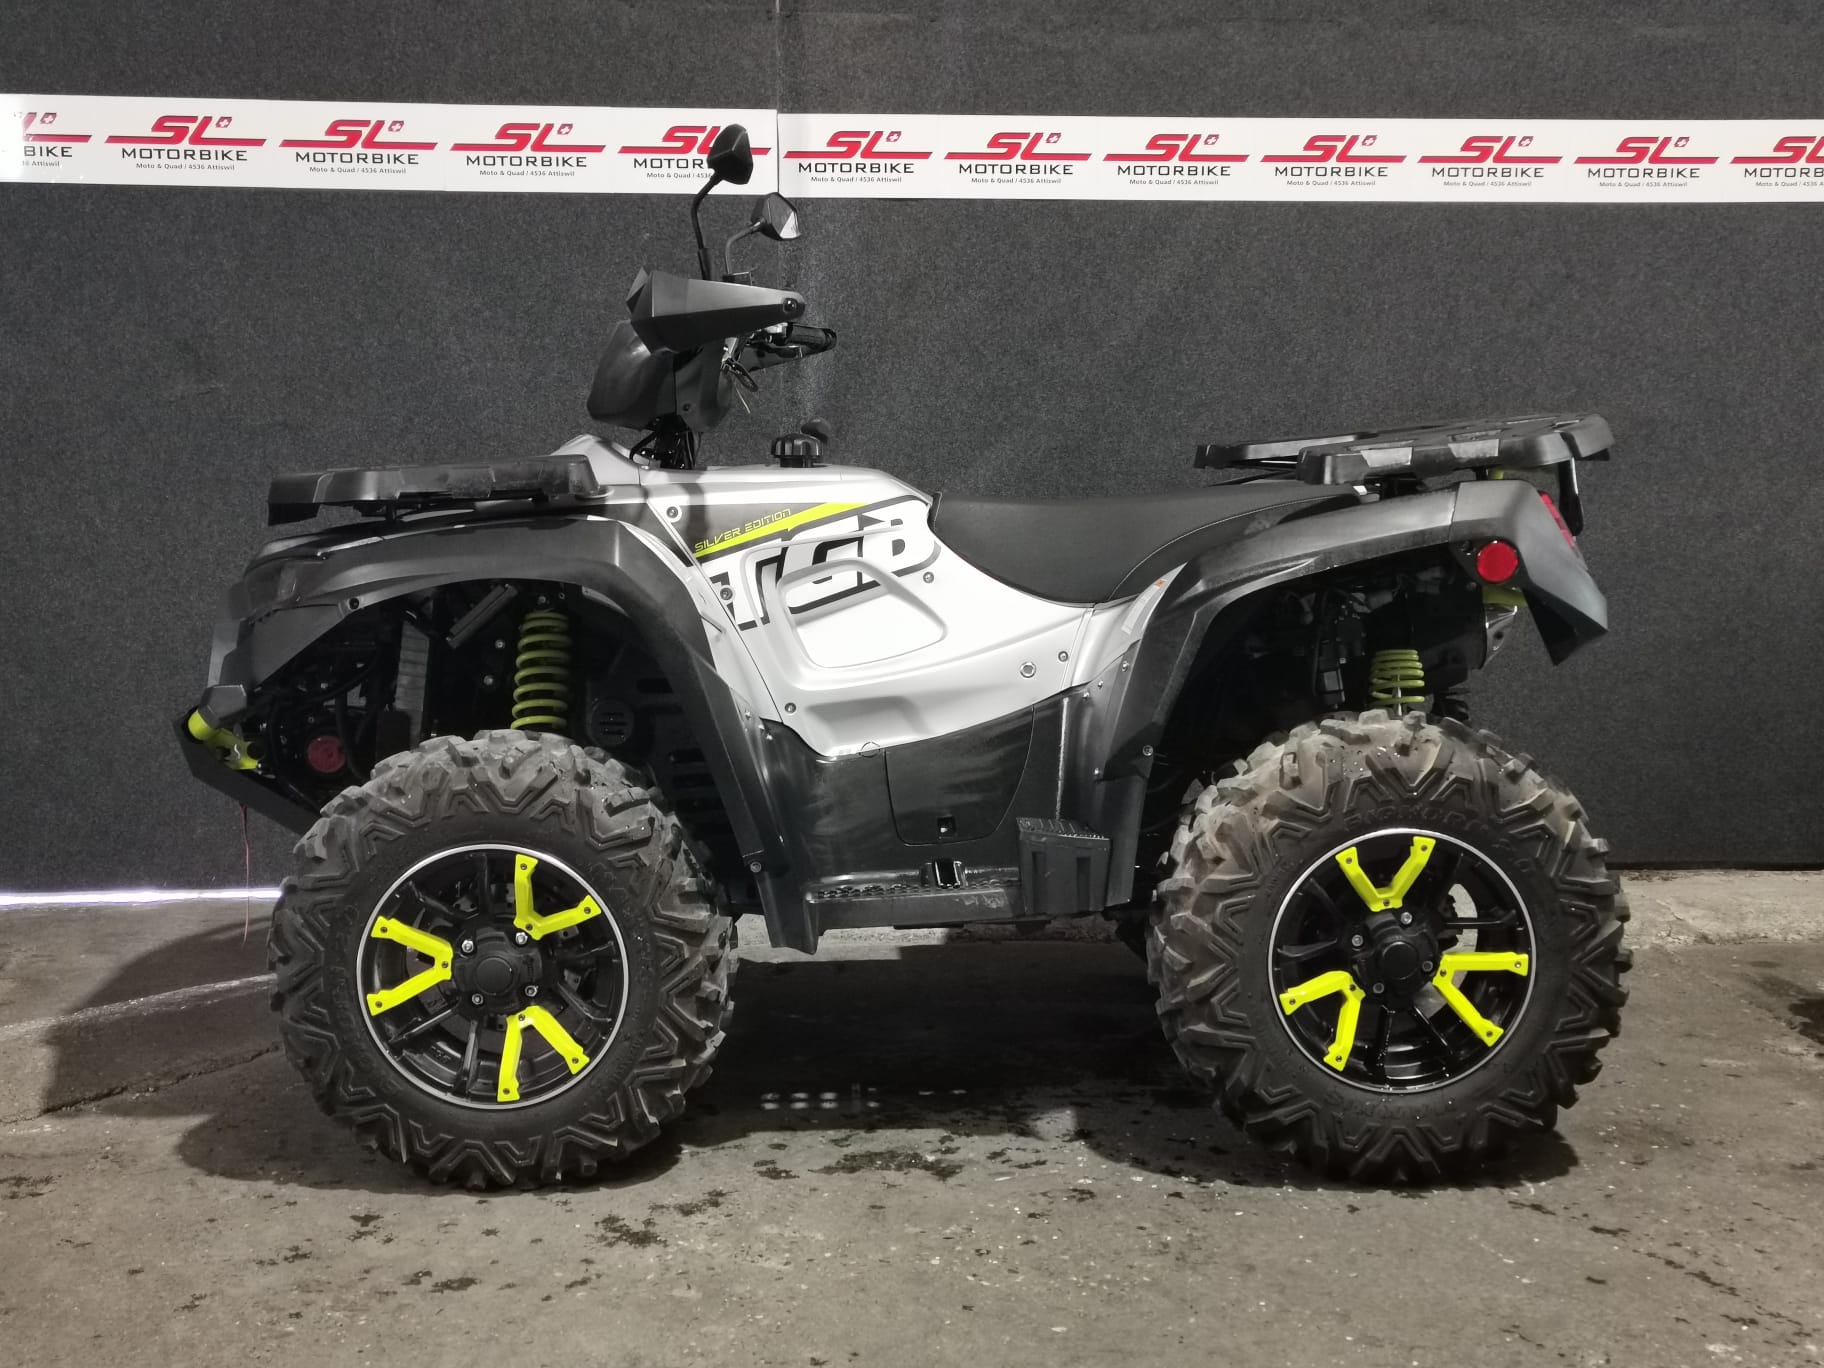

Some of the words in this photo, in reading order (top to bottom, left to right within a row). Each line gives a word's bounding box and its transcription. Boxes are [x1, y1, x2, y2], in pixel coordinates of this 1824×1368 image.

[122, 148, 248, 161] MOTORBIKE
[296, 152, 419, 164] MOTORBIKE
[467, 156, 587, 167] MOTORBIKE
[634, 158, 704, 169] MOTOR
[799, 163, 914, 173] MOTORBIKE
[959, 164, 1074, 175] MOTORBIKE
[1118, 166, 1231, 176] MOTORBIKE
[1275, 167, 1388, 177] MOTORBIKE
[1432, 168, 1544, 177] MOTORBIKE
[1588, 168, 1700, 178] MOTORBIKE
[694, 527, 742, 552] SILVER
[744, 508, 792, 532] EDITION
[702, 496, 938, 631] TGB
